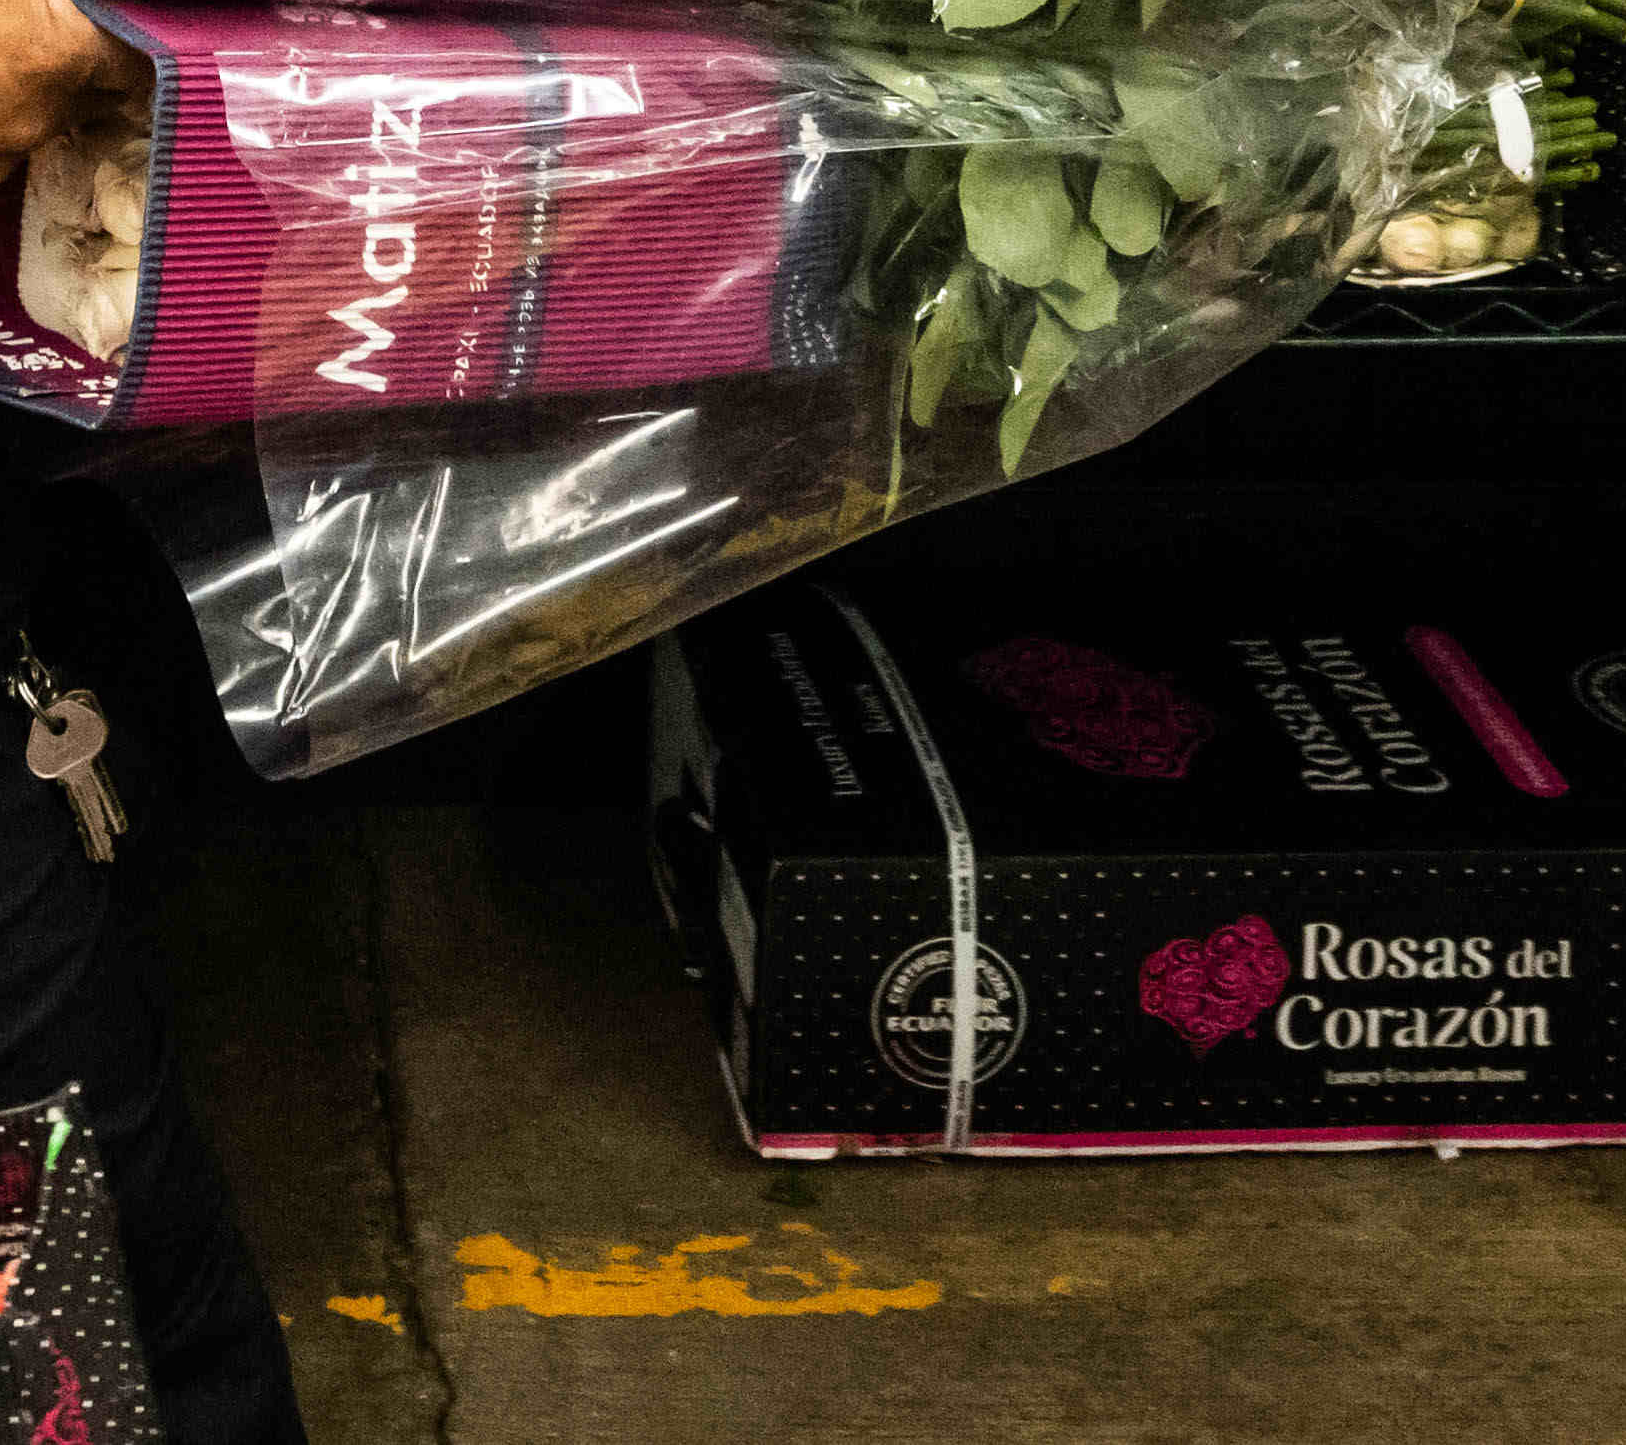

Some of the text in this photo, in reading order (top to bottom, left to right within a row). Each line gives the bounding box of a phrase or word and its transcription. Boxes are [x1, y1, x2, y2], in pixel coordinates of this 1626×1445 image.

[315, 99, 420, 393] Matiz
[1256, 682, 1373, 792] Rosas
[1299, 637, 1451, 795] Corazón
[1301, 920, 1575, 982] Rosas del
[885, 1015, 1014, 1032] ECUAOR
[1274, 989, 1554, 1052] Corazón
